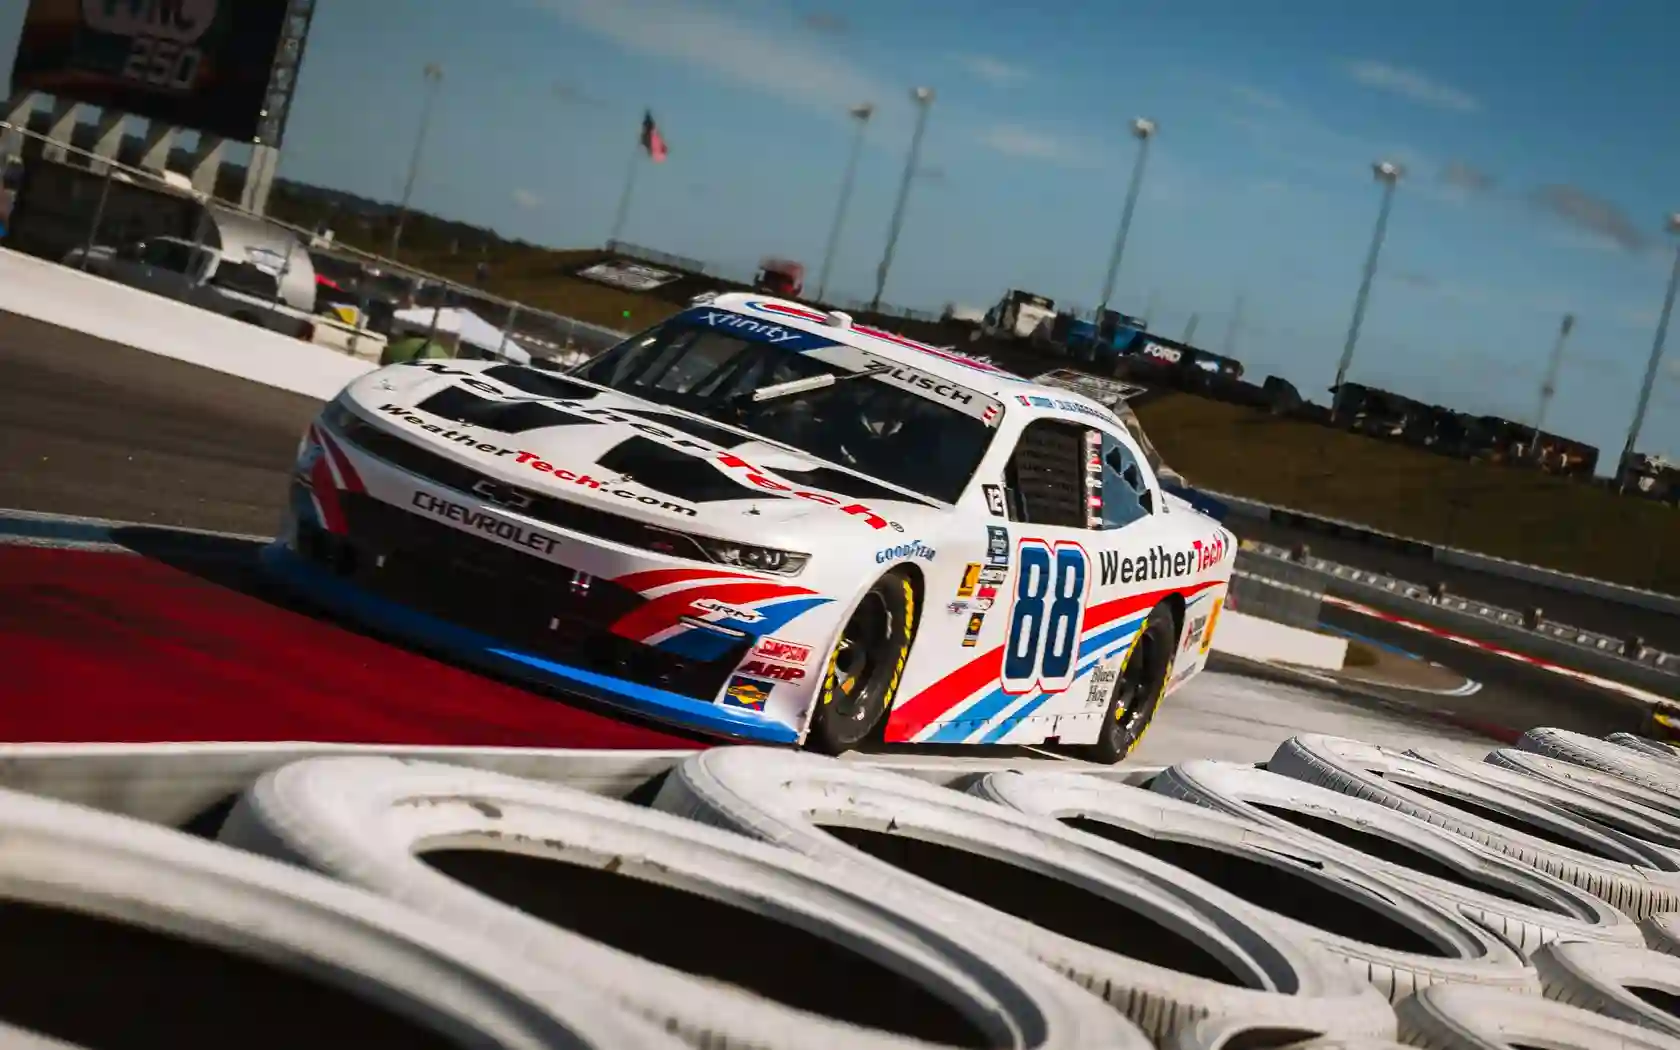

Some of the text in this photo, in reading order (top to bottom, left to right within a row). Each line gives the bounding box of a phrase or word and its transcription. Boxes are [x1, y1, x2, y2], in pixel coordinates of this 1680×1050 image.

[122, 37, 201, 90] 250
[1143, 341, 1182, 363] FORD
[377, 403, 697, 517] WeatherTech.com
[411, 491, 563, 554] CHEVROLET
[875, 540, 936, 563] GOODYEAR
[1099, 536, 1224, 586] WeatherTech
[695, 601, 756, 621] JRM
[1003, 541, 1088, 688] 88
[738, 661, 806, 680] ARP
